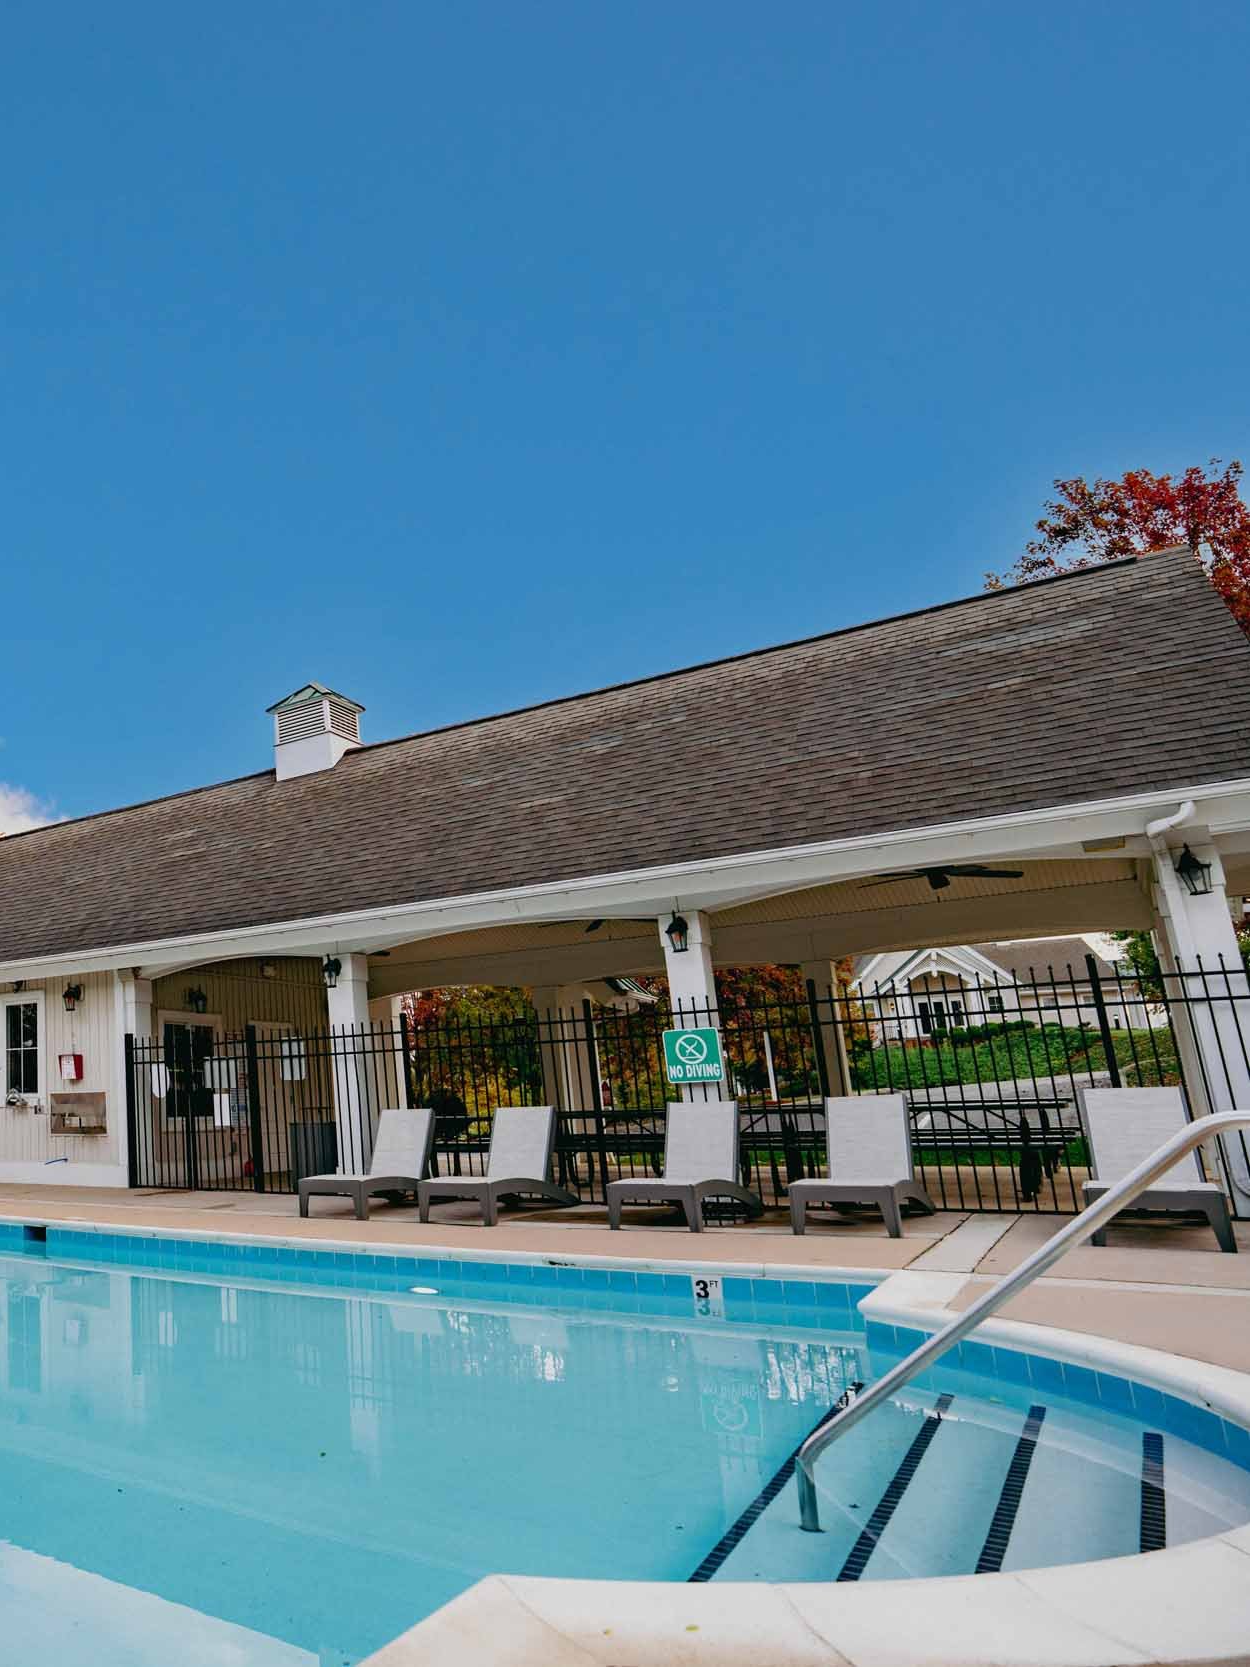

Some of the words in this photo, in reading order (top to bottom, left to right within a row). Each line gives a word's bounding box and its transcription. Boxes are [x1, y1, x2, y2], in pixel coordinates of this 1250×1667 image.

[669, 1065, 684, 1079] NO
[686, 1064, 720, 1078] DIVING
[695, 1279, 710, 1299] 3
[710, 1280, 719, 1288] FT
